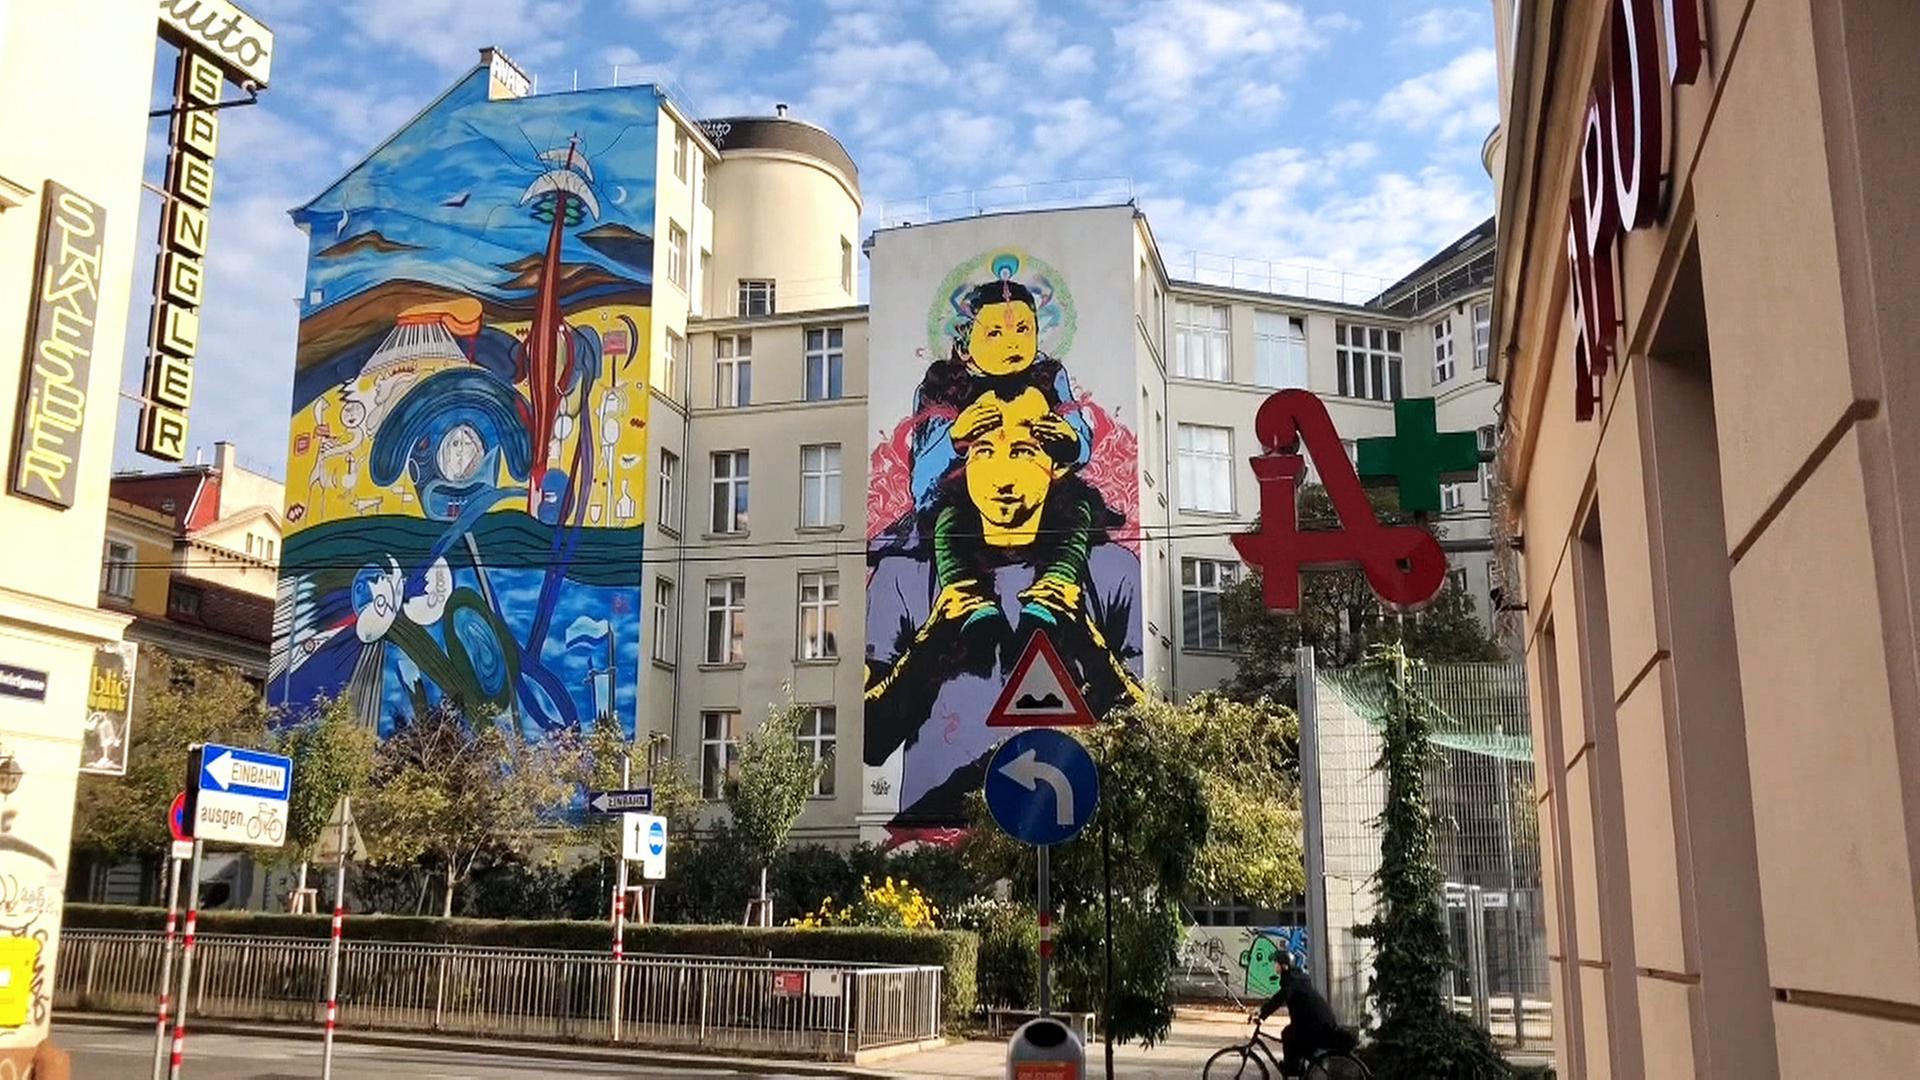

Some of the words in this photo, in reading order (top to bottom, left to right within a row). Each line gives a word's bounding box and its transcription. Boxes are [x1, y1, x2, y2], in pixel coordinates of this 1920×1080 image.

[159, 0, 268, 67] uto
[158, 63, 218, 452] SPENGLER
[231, 762, 281, 787] EINBAHN
